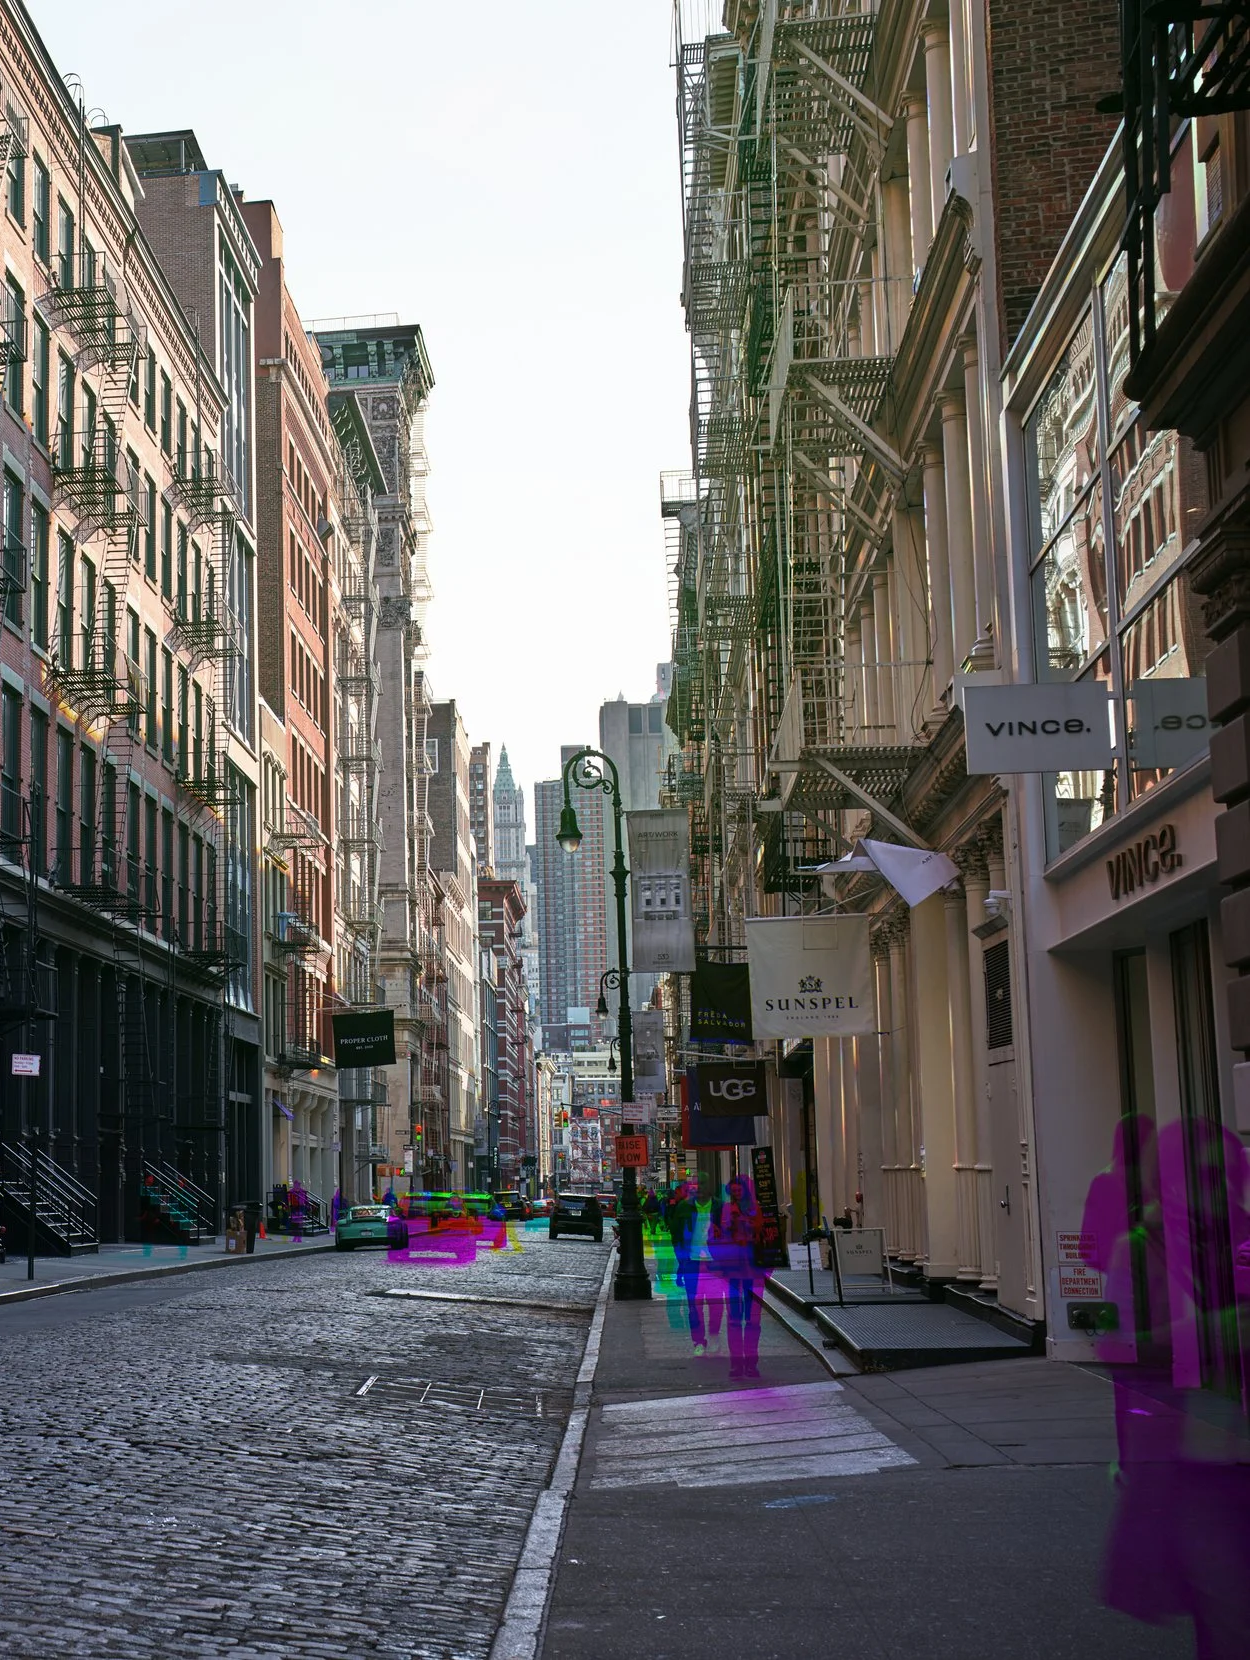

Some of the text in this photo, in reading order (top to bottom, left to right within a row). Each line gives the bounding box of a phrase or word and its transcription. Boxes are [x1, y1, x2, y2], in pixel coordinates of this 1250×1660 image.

[637, 831, 679, 839] ART/WORK
[765, 996, 860, 1012] SUNSPEL
[697, 1019, 746, 1029] SALVADOR
[709, 1079, 756, 1100] UGG
[1073, 1268, 1086, 1276] FIRE
[1061, 1277, 1098, 1285] DEPARTMENT
[1064, 1287, 1098, 1295] CONNECTION
